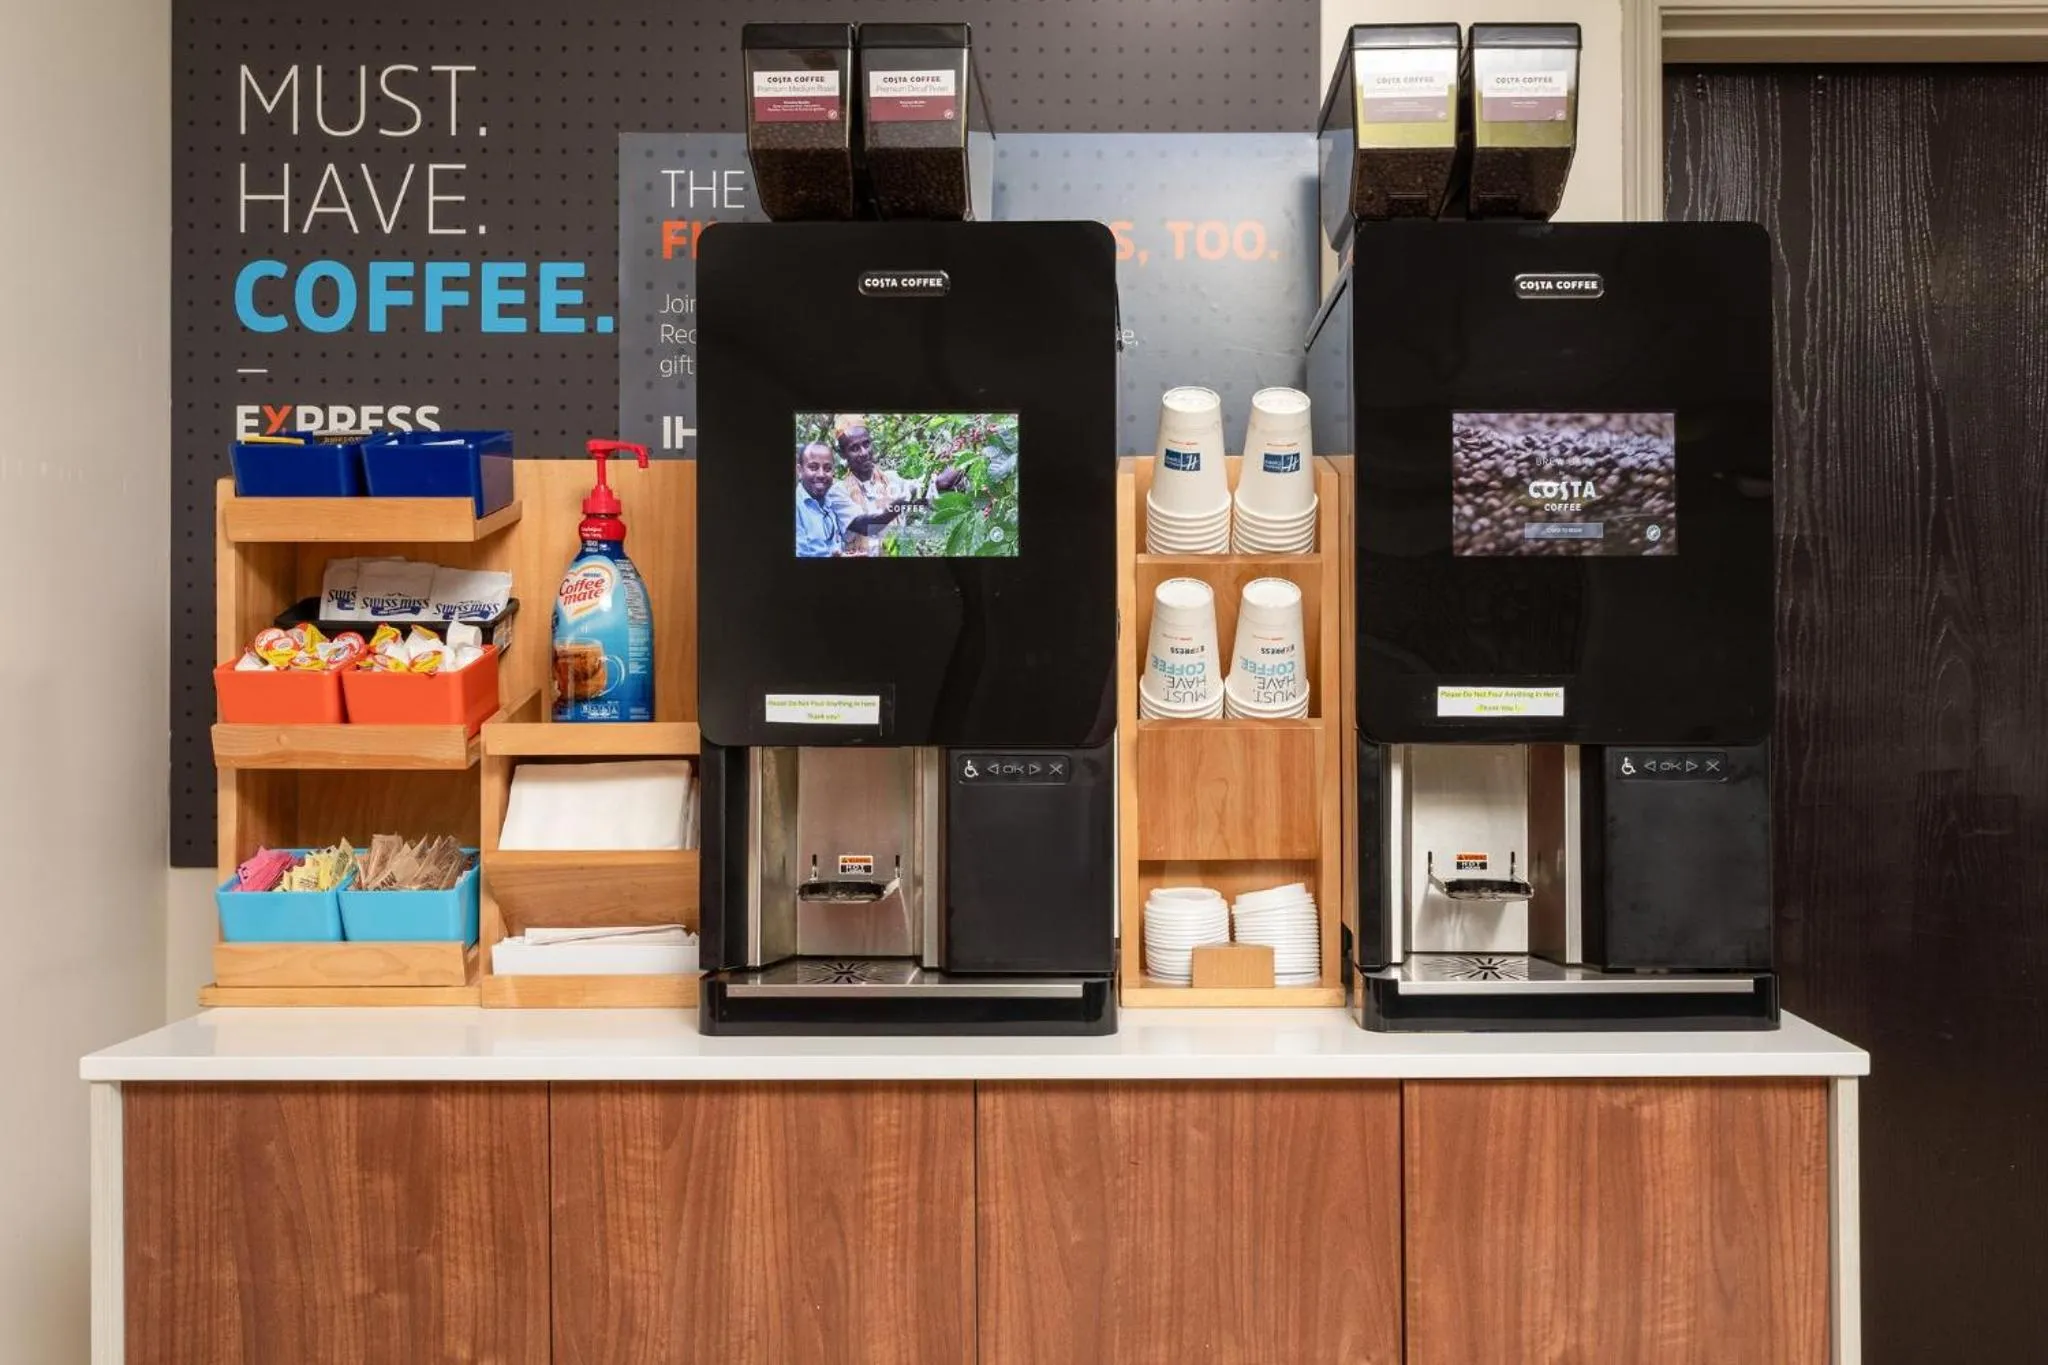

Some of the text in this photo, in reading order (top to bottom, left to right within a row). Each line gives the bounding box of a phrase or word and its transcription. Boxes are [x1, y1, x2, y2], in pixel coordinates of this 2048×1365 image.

[767, 75, 825, 84] COSTA COFFEE
[883, 75, 941, 84] COSTA COFFEE
[240, 64, 487, 137] MUST.
[239, 162, 486, 234] HAVE.
[660, 169, 745, 208] THE
[1164, 219, 1281, 262] TOO.
[864, 278, 943, 289] COSTA COFFEE
[1519, 280, 1599, 291] COSTA COFFEE
[235, 259, 614, 333] COFFEE.
[659, 354, 695, 378] gift
[1528, 481, 1597, 501] COSTA
[1543, 503, 1583, 512] COFFEE
[559, 578, 606, 597] Coffee
[562, 587, 605, 607] mate
